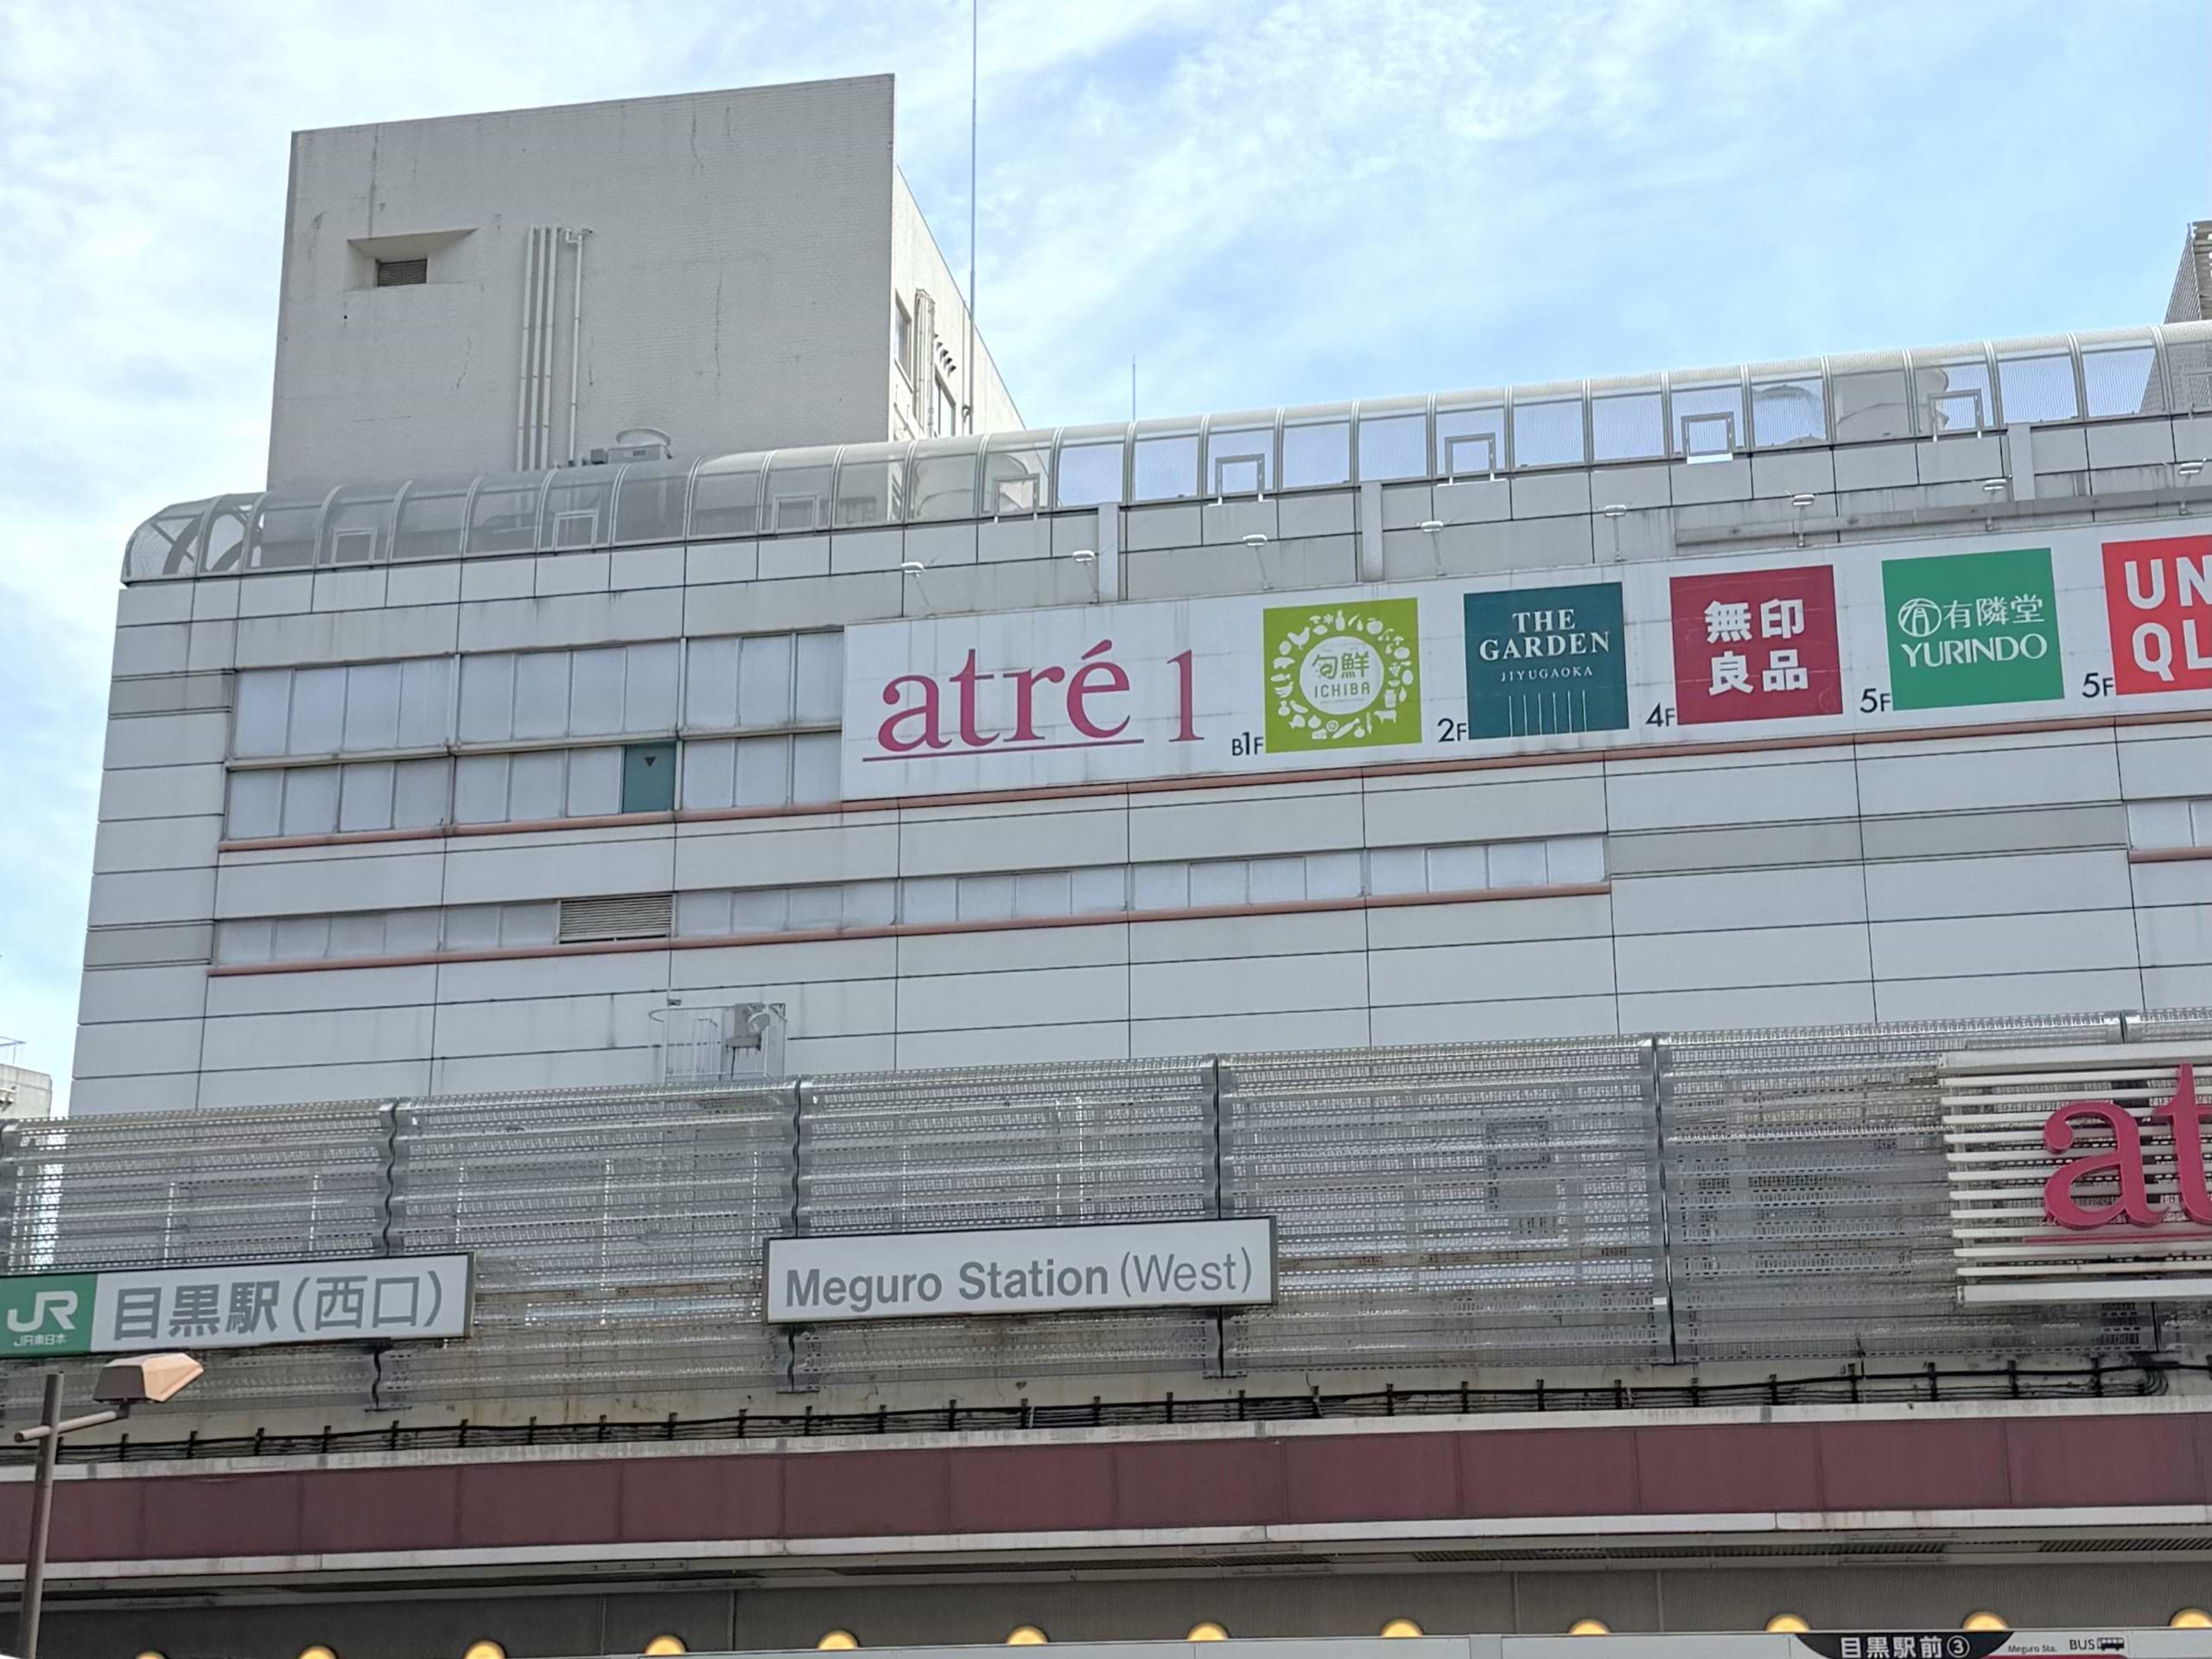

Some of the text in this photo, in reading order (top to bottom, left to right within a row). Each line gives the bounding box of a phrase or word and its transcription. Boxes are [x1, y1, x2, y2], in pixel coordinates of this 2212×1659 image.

[1511, 609, 1576, 634] THE
[1704, 598, 1805, 644] 無印
[1942, 594, 2045, 629] 有隣堂
[1478, 631, 1611, 662] GARDEN
[1901, 632, 2048, 667] YURINDO
[1312, 651, 1370, 680] 旬鮮
[1501, 665, 1593, 683] JIYUGAOKA
[1708, 648, 1808, 696] 良品
[877, 639, 1205, 753] atré 1
[1314, 681, 1370, 699] ICHIBA
[2082, 672, 2114, 698] 5F
[1645, 702, 1676, 728] 4F
[1859, 689, 1891, 714] 5F
[1438, 718, 1468, 743] 2F
[1231, 732, 1264, 757] B1F
[785, 1247, 1253, 1313] Meguro Station (West)
[7, 1290, 79, 1332] JR
[2069, 1639, 2095, 1650] BUS
